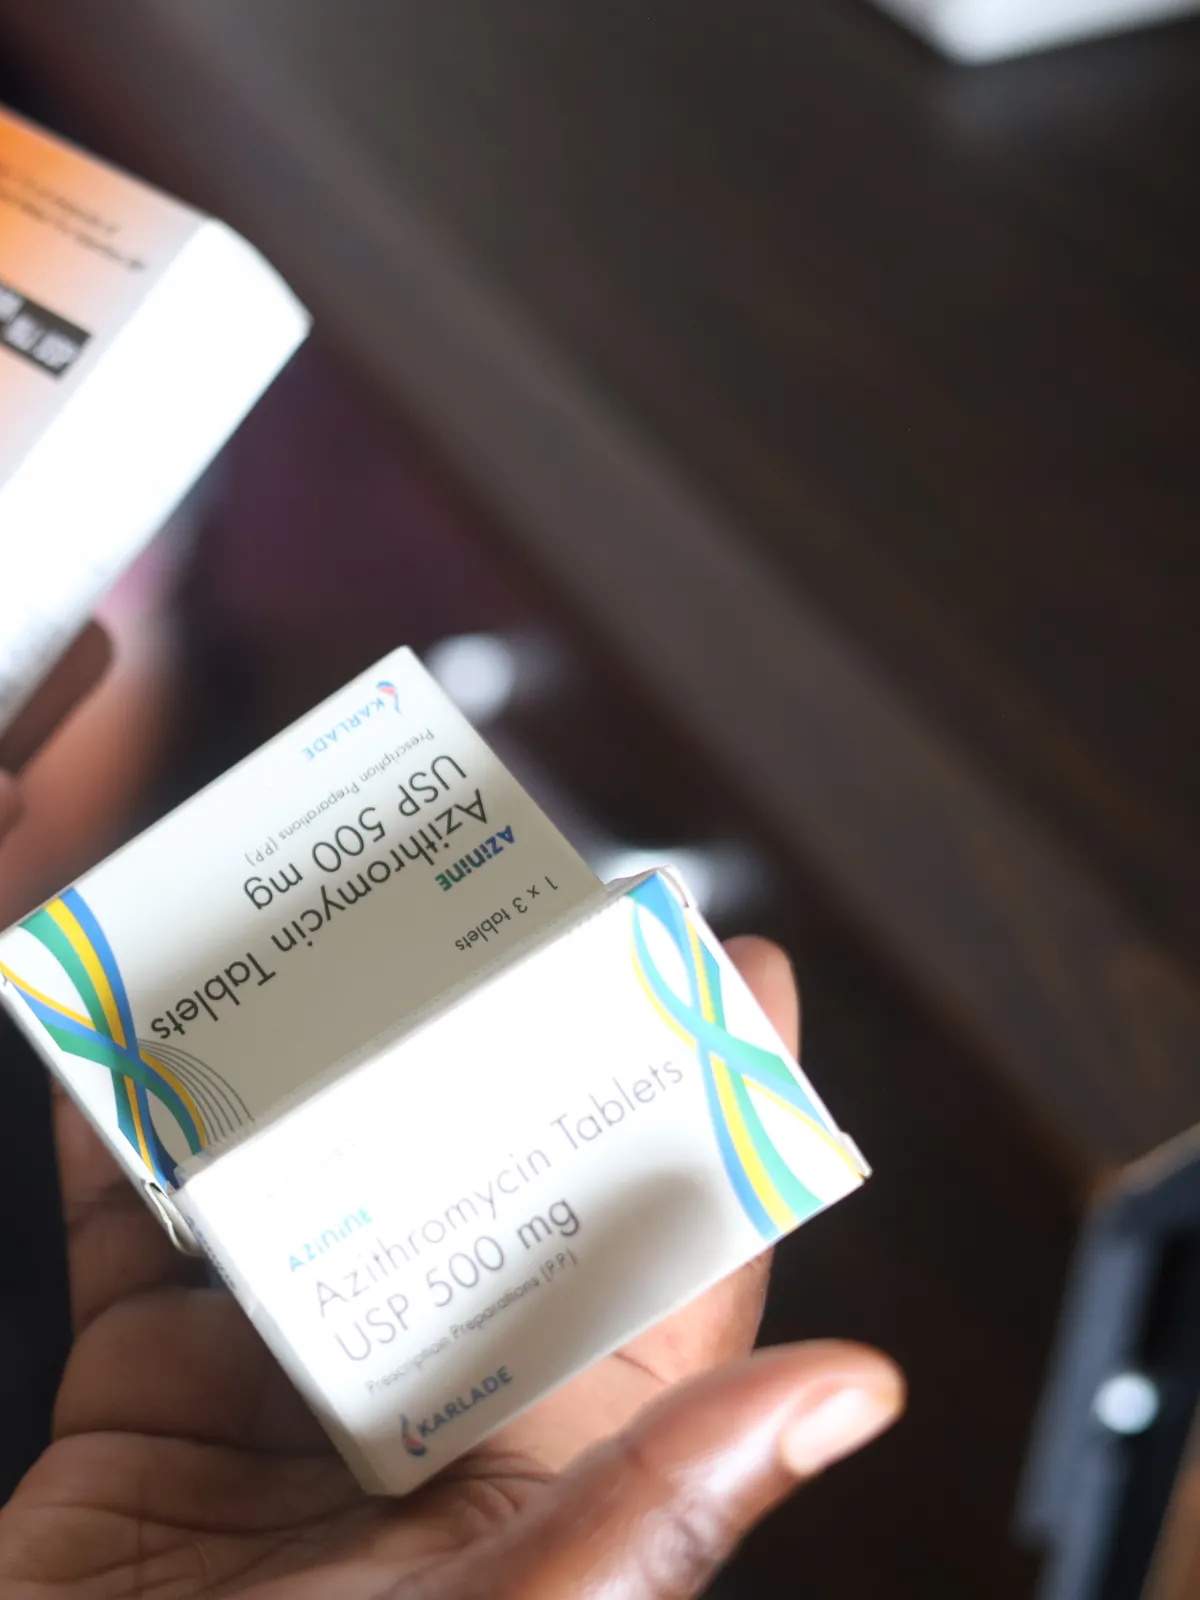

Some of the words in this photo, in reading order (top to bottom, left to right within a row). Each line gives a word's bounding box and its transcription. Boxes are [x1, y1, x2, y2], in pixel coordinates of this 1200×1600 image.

[303, 697, 385, 762] KARLADE
[358, 728, 435, 784] Prescription
[278, 781, 360, 842] Preparations
[398, 755, 467, 817] USP
[270, 788, 488, 952] Azithromycin
[312, 806, 386, 873] 500
[243, 863, 303, 910] mg
[511, 897, 528, 914] 3
[526, 885, 541, 899] x
[544, 876, 558, 891] 1
[455, 908, 511, 952] tablets
[151, 952, 276, 1039] Tablets
[315, 1146, 553, 1318] Azithromycin
[550, 1060, 683, 1151] Tablets
[334, 1293, 409, 1362] USP
[426, 1235, 504, 1307] 500
[517, 1198, 580, 1250] mg
[451, 1277, 540, 1341] Preparations
[416, 1365, 513, 1438] KARLADE
